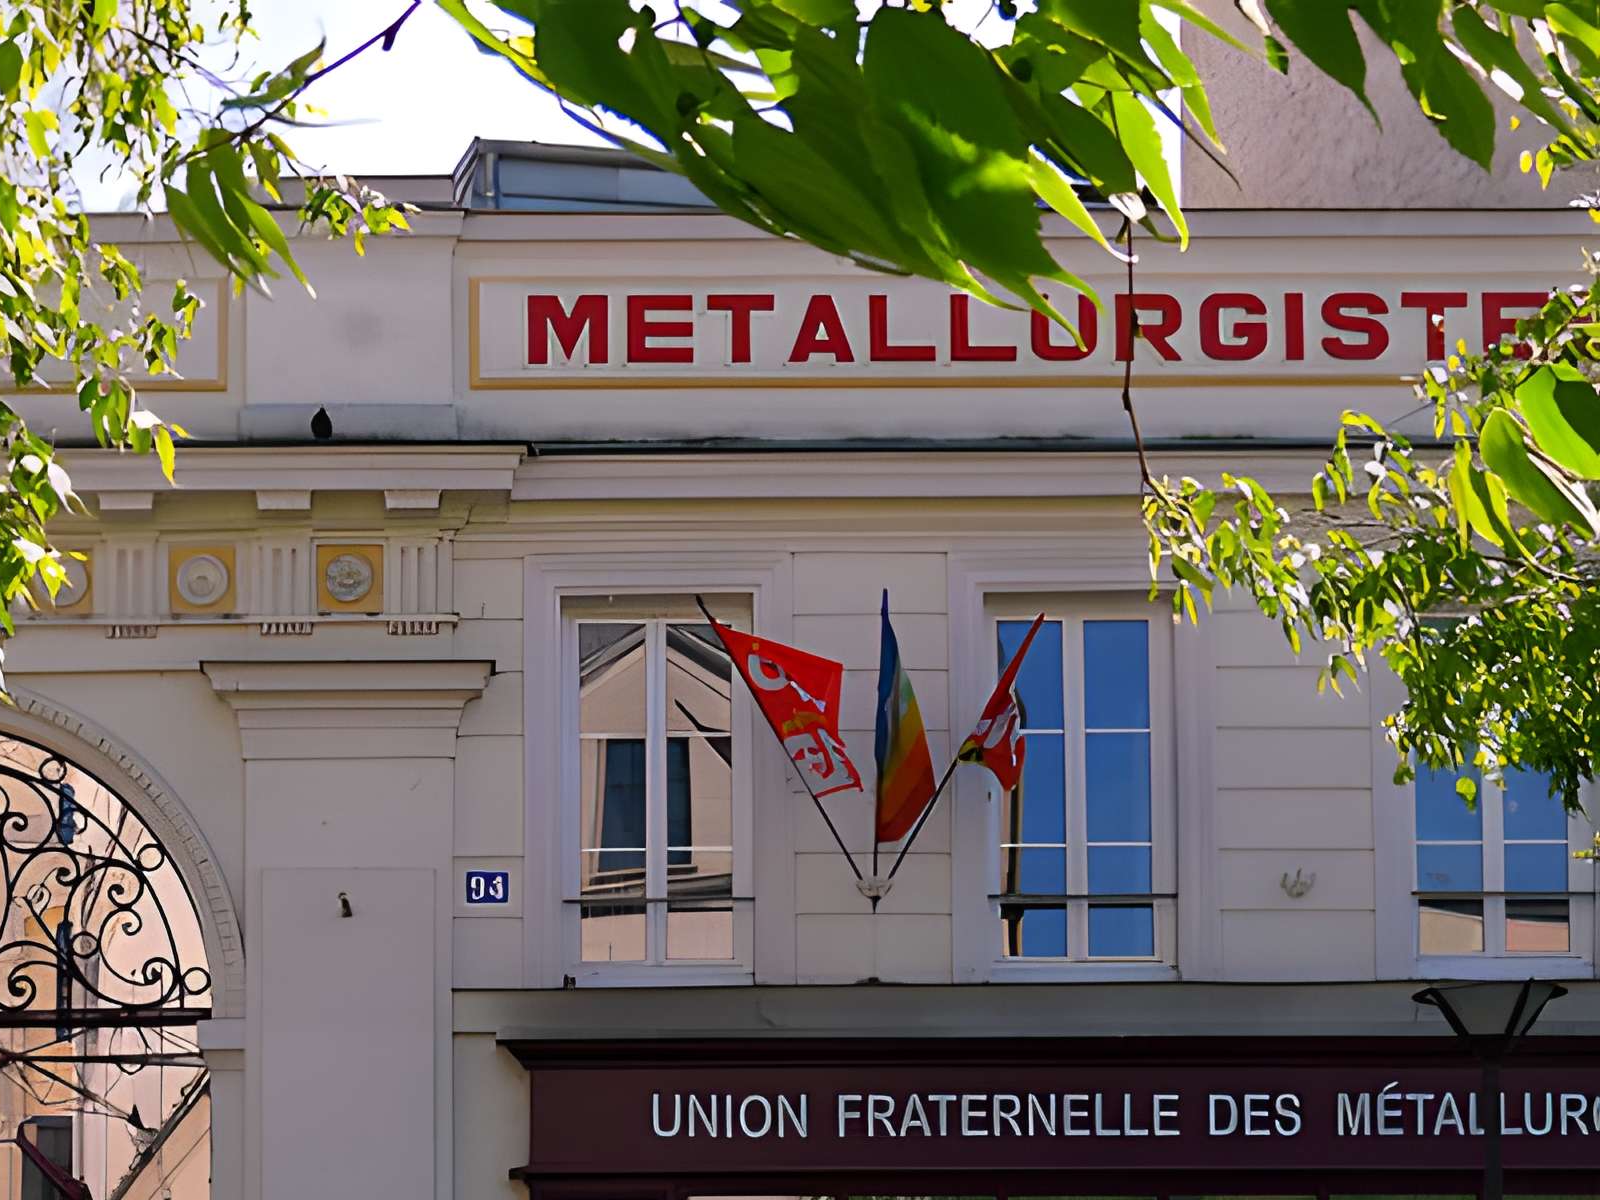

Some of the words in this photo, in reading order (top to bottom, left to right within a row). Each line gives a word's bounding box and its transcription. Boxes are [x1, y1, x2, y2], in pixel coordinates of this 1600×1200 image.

[528, 291, 1593, 364] METALLURGISTE
[470, 875, 503, 900] 93
[652, 1092, 808, 1139] UNION
[837, 1092, 1181, 1138] FRATERNELLE
[1208, 1092, 1302, 1137] DES
[1337, 1080, 1600, 1136] MÉTALLUR
